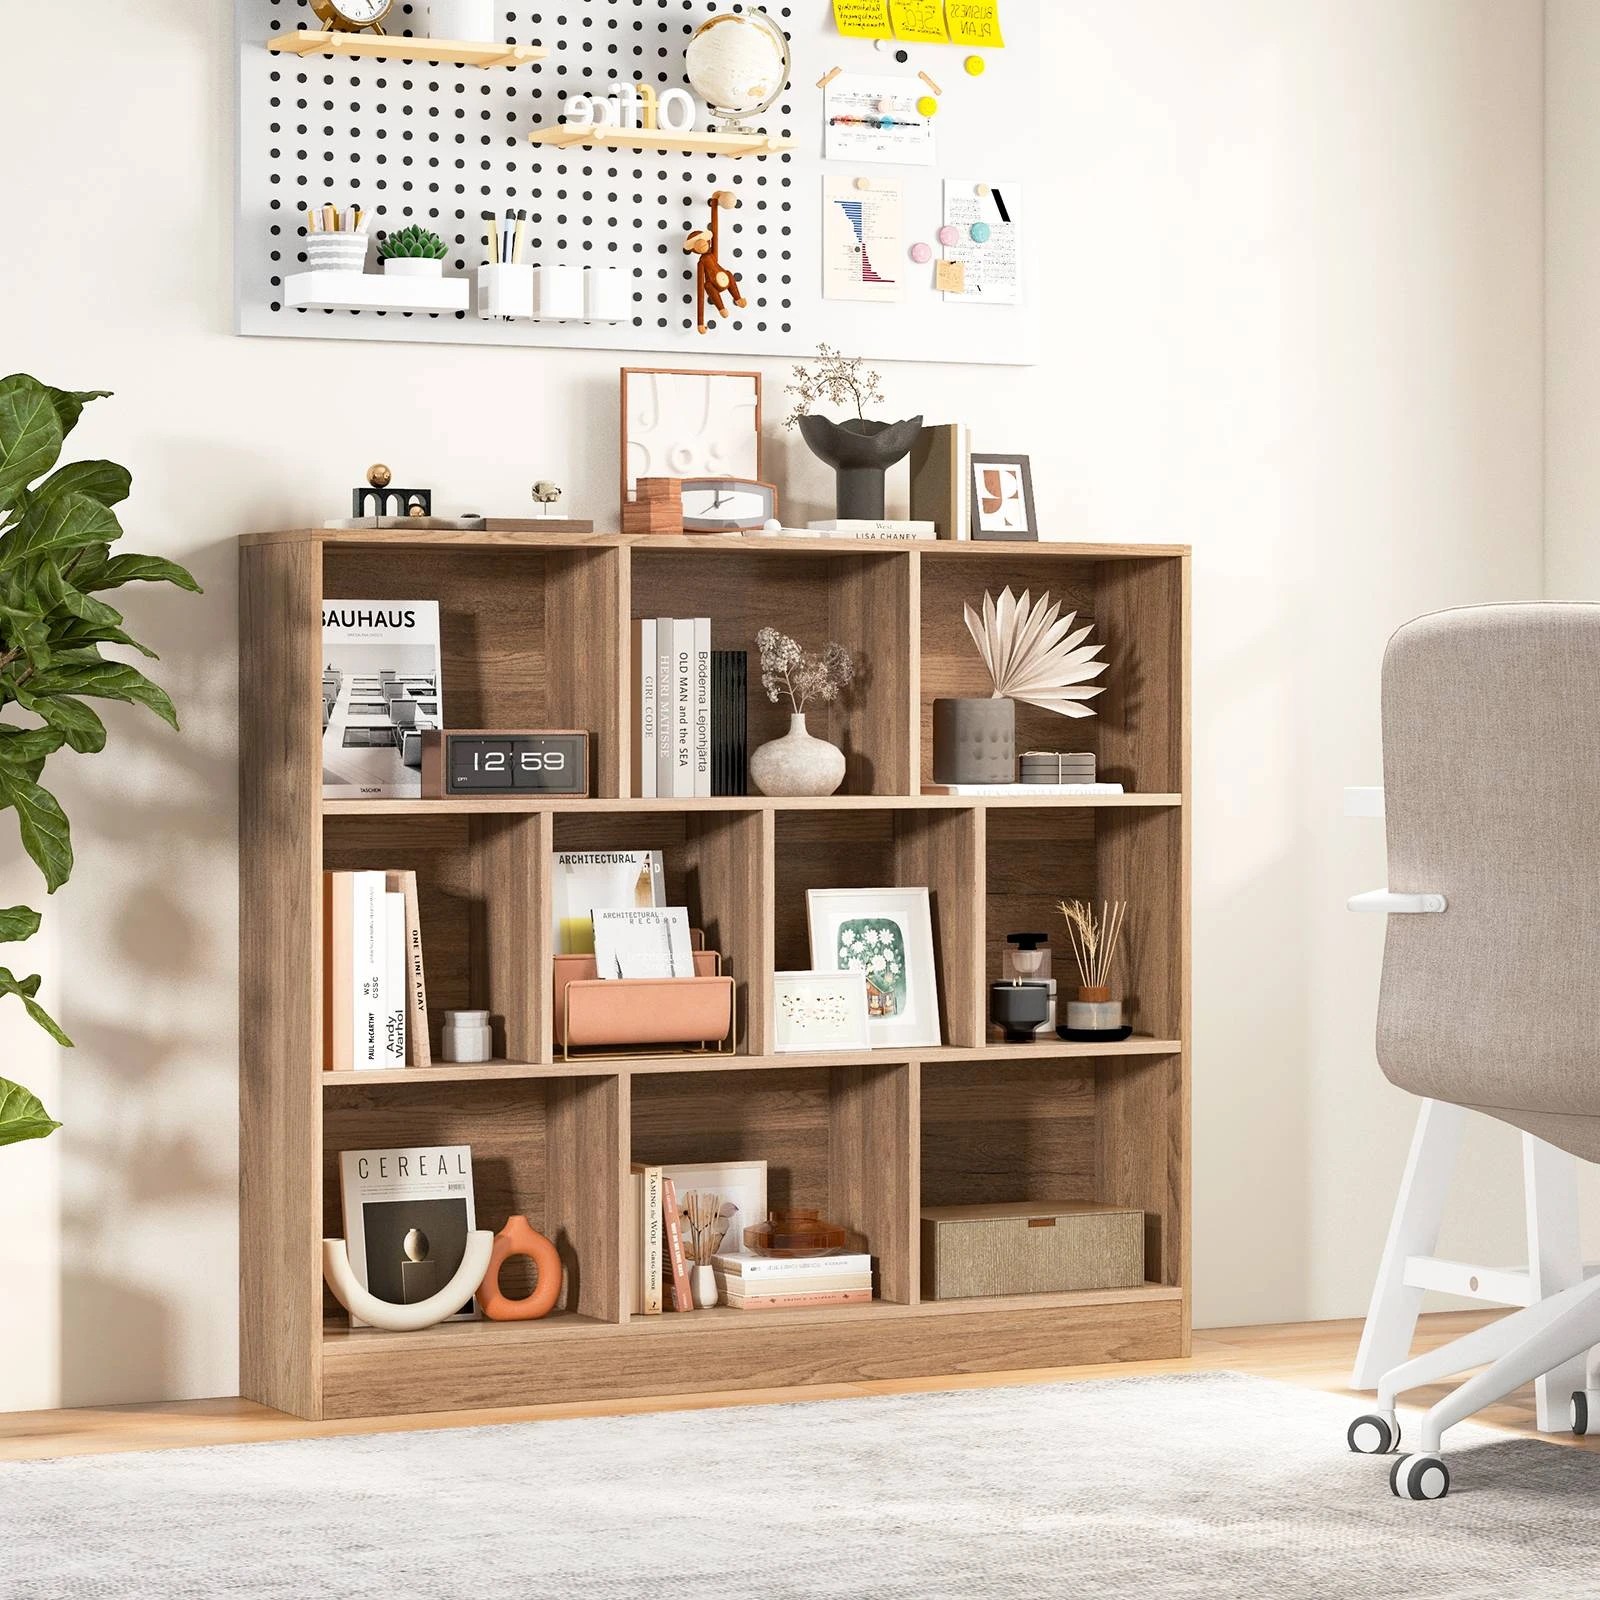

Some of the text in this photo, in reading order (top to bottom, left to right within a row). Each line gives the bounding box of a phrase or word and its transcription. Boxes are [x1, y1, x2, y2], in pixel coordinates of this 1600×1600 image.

[856, 532, 917, 540] LISA CHANEY
[645, 676, 653, 738] GIRL CODE
[660, 655, 670, 758] HENRI MATISSE
[679, 652, 688, 767] OLD MAN and the SEA
[696, 651, 708, 773] Bröderna Lejonhjärta
[559, 853, 637, 865] ARCHITECTURAL
[603, 911, 659, 919] ARCHITECTURAL
[414, 955, 422, 976] LINE
[363, 982, 370, 995] WS
[417, 992, 425, 1011] DAY
[386, 1015, 397, 1052] Andy
[395, 1009, 403, 1059] Warhol
[358, 1154, 466, 1180] CEREAL
[649, 1172, 658, 1208] TAMING
[649, 1220, 658, 1245] WOLF
